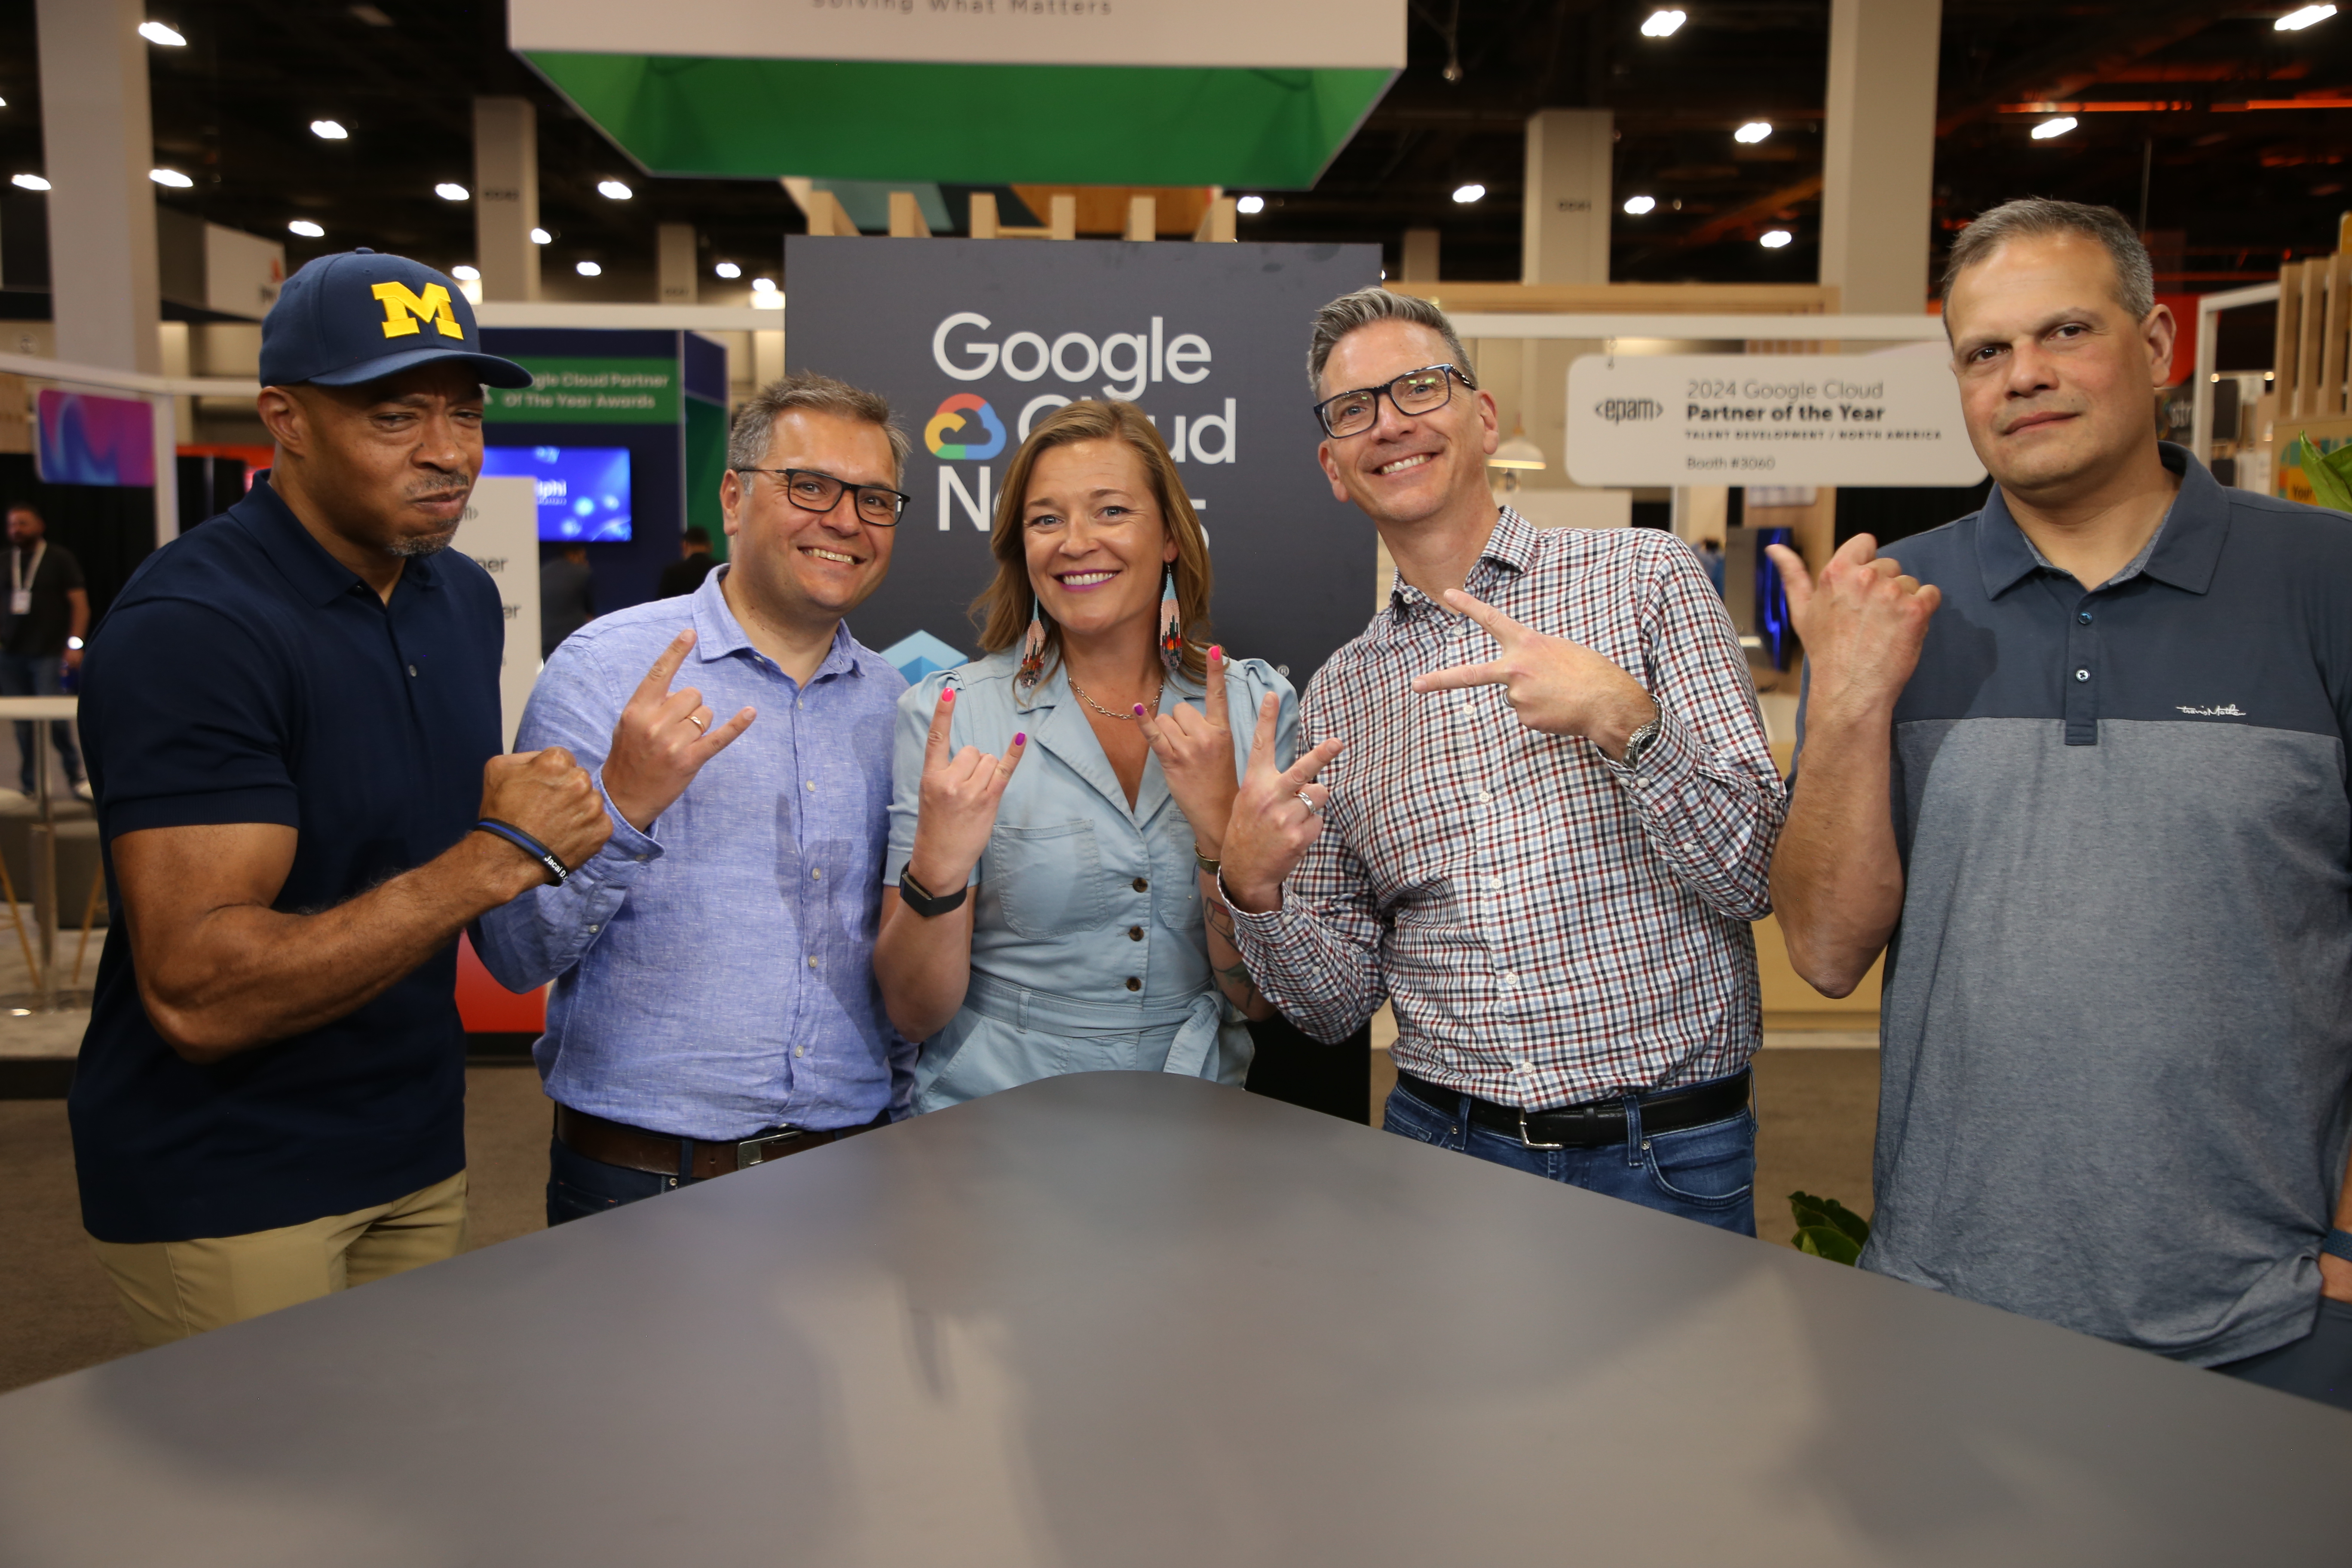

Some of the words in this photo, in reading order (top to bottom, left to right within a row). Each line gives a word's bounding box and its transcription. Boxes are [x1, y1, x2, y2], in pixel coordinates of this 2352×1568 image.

[1011, 0, 1112, 15] Matters
[371, 281, 464, 340] M
[933, 312, 1212, 401] Google
[562, 372, 608, 386] Cloud
[612, 373, 669, 386] Partner
[1687, 379, 1736, 399] 2024
[1744, 379, 1817, 404] Google
[1823, 379, 1883, 399] Cloud
[503, 393, 523, 407] Of
[525, 393, 554, 408] The
[556, 393, 592, 408] Year
[596, 393, 655, 409] Awards
[1687, 404, 1766, 421] Partner
[1771, 405, 1794, 421] of
[1799, 406, 1833, 421] the
[1839, 404, 1886, 421] Year
[1018, 394, 1237, 464] Cud
[1685, 430, 1729, 440] TALENT
[1736, 430, 1824, 440] DEVELOPMENT
[1840, 431, 1882, 440] NORTH
[1887, 431, 1942, 440] AMERICA
[1687, 456, 1727, 470] Booth
[1731, 456, 1776, 470] #3060
